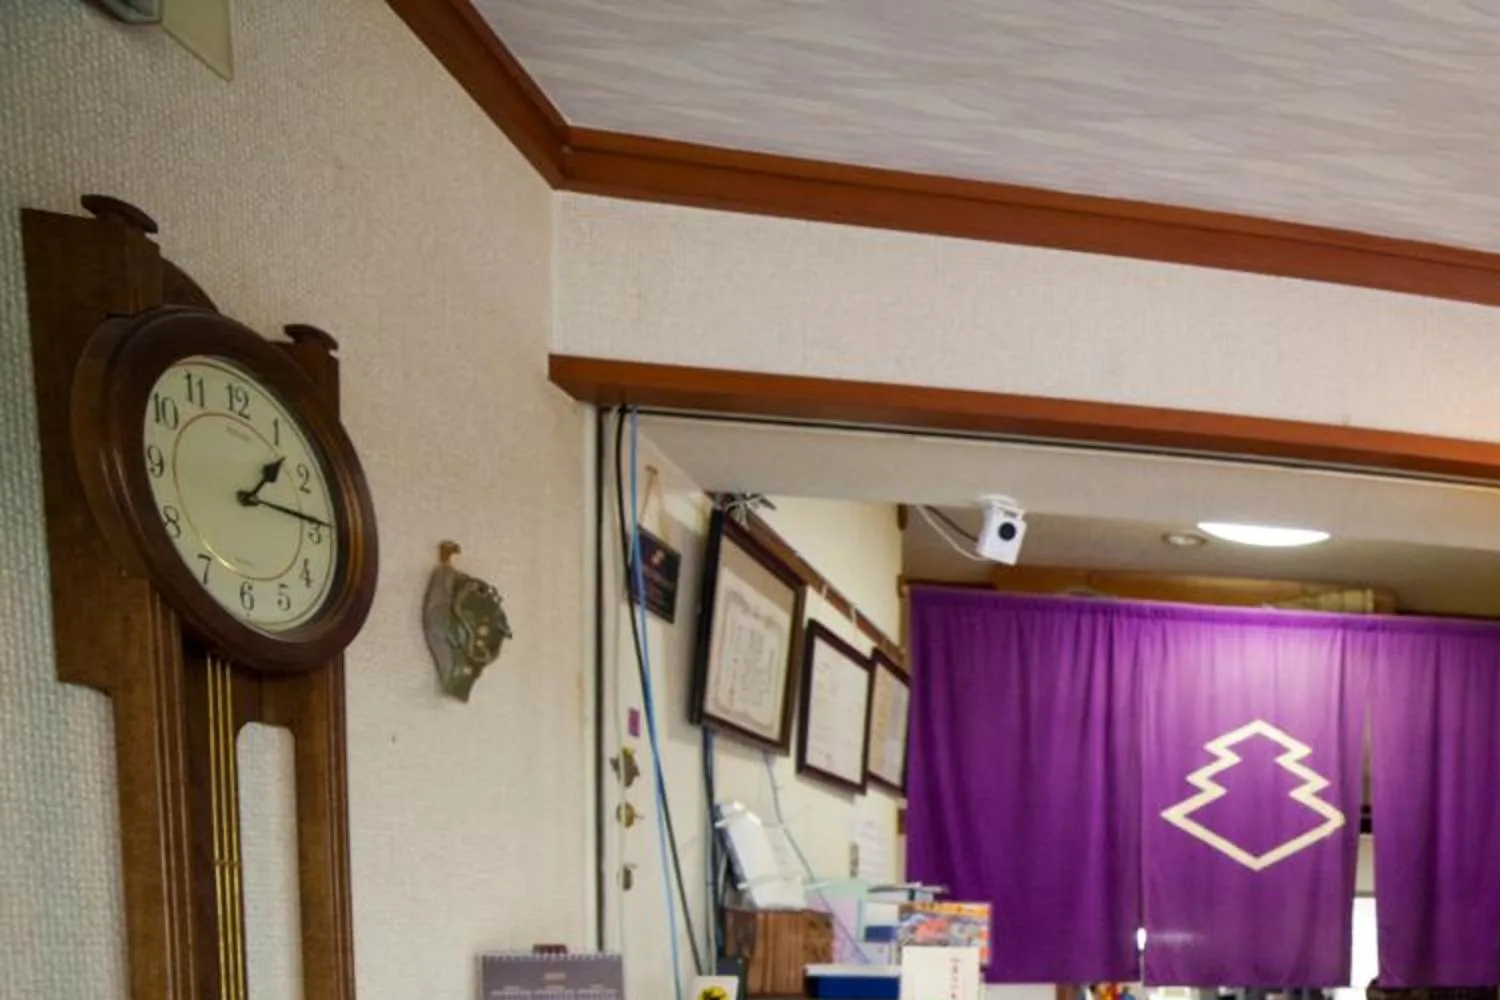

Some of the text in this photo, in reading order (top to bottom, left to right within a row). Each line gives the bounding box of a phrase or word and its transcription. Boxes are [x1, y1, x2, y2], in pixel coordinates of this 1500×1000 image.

[185, 369, 205, 409] 11
[226, 382, 252, 420] 12
[153, 392, 179, 430] 10
[272, 418, 280, 446] 1
[147, 445, 165, 478] 9
[296, 463, 311, 494] 2
[163, 505, 181, 539] 8
[307, 518, 322, 545] 3
[198, 553, 212, 586] 7
[299, 557, 313, 588] 4
[239, 581, 255, 612] 6
[277, 583, 291, 612] 5
